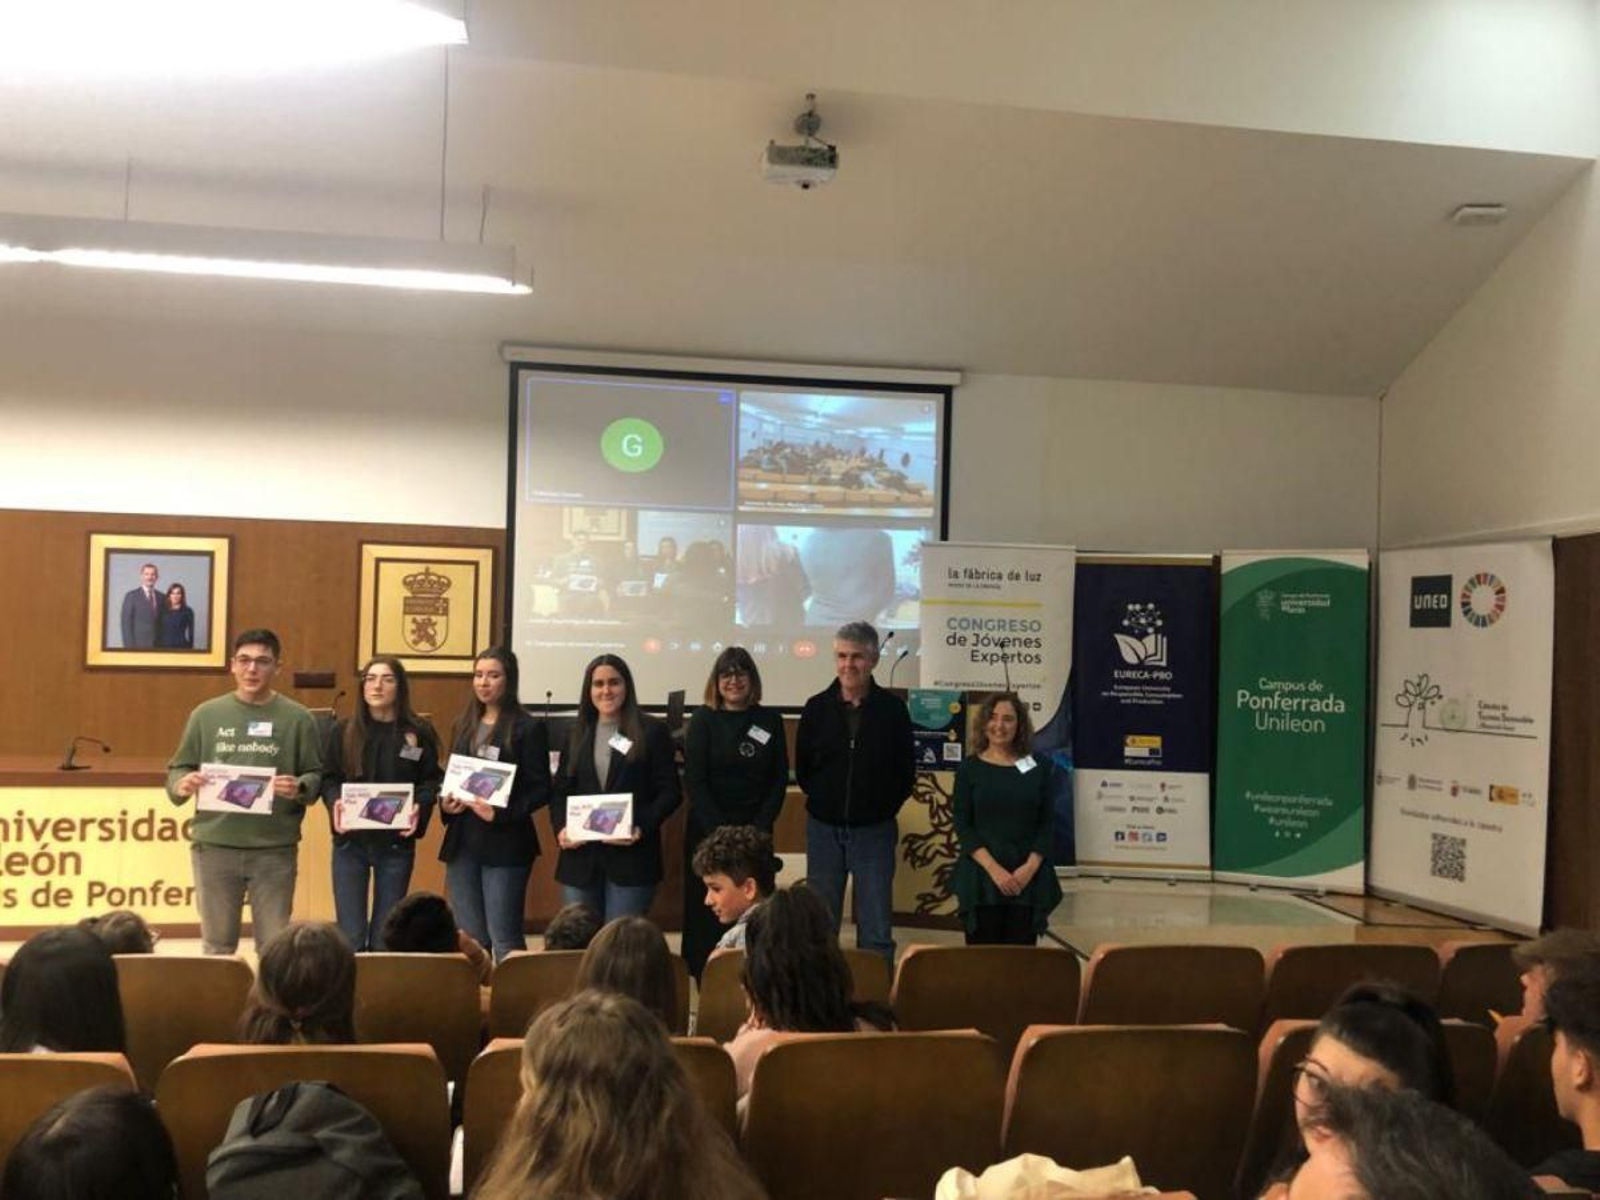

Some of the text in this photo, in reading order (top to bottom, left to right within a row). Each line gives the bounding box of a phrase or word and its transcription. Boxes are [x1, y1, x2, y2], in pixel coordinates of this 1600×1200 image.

[622, 434, 643, 457] G
[947, 566, 1042, 582] la fábrica de luz
[1281, 598, 1330, 607] universidad
[1414, 593, 1448, 610] UNED
[946, 617, 1042, 633] CONGRESO
[946, 632, 1042, 649] de Jóvenes
[970, 650, 1042, 665] Expertos
[1113, 670, 1173, 680] EURECA-PRO
[1258, 677, 1323, 692] Campus de
[1236, 689, 1346, 713] Ponferrada
[1255, 711, 1326, 733] Unileon
[217, 727, 236, 738] Act
[216, 742, 280, 756] like nobody
[0, 843, 82, 876] eón
[31, 881, 73, 907] de
[87, 880, 196, 907] Ponfer
